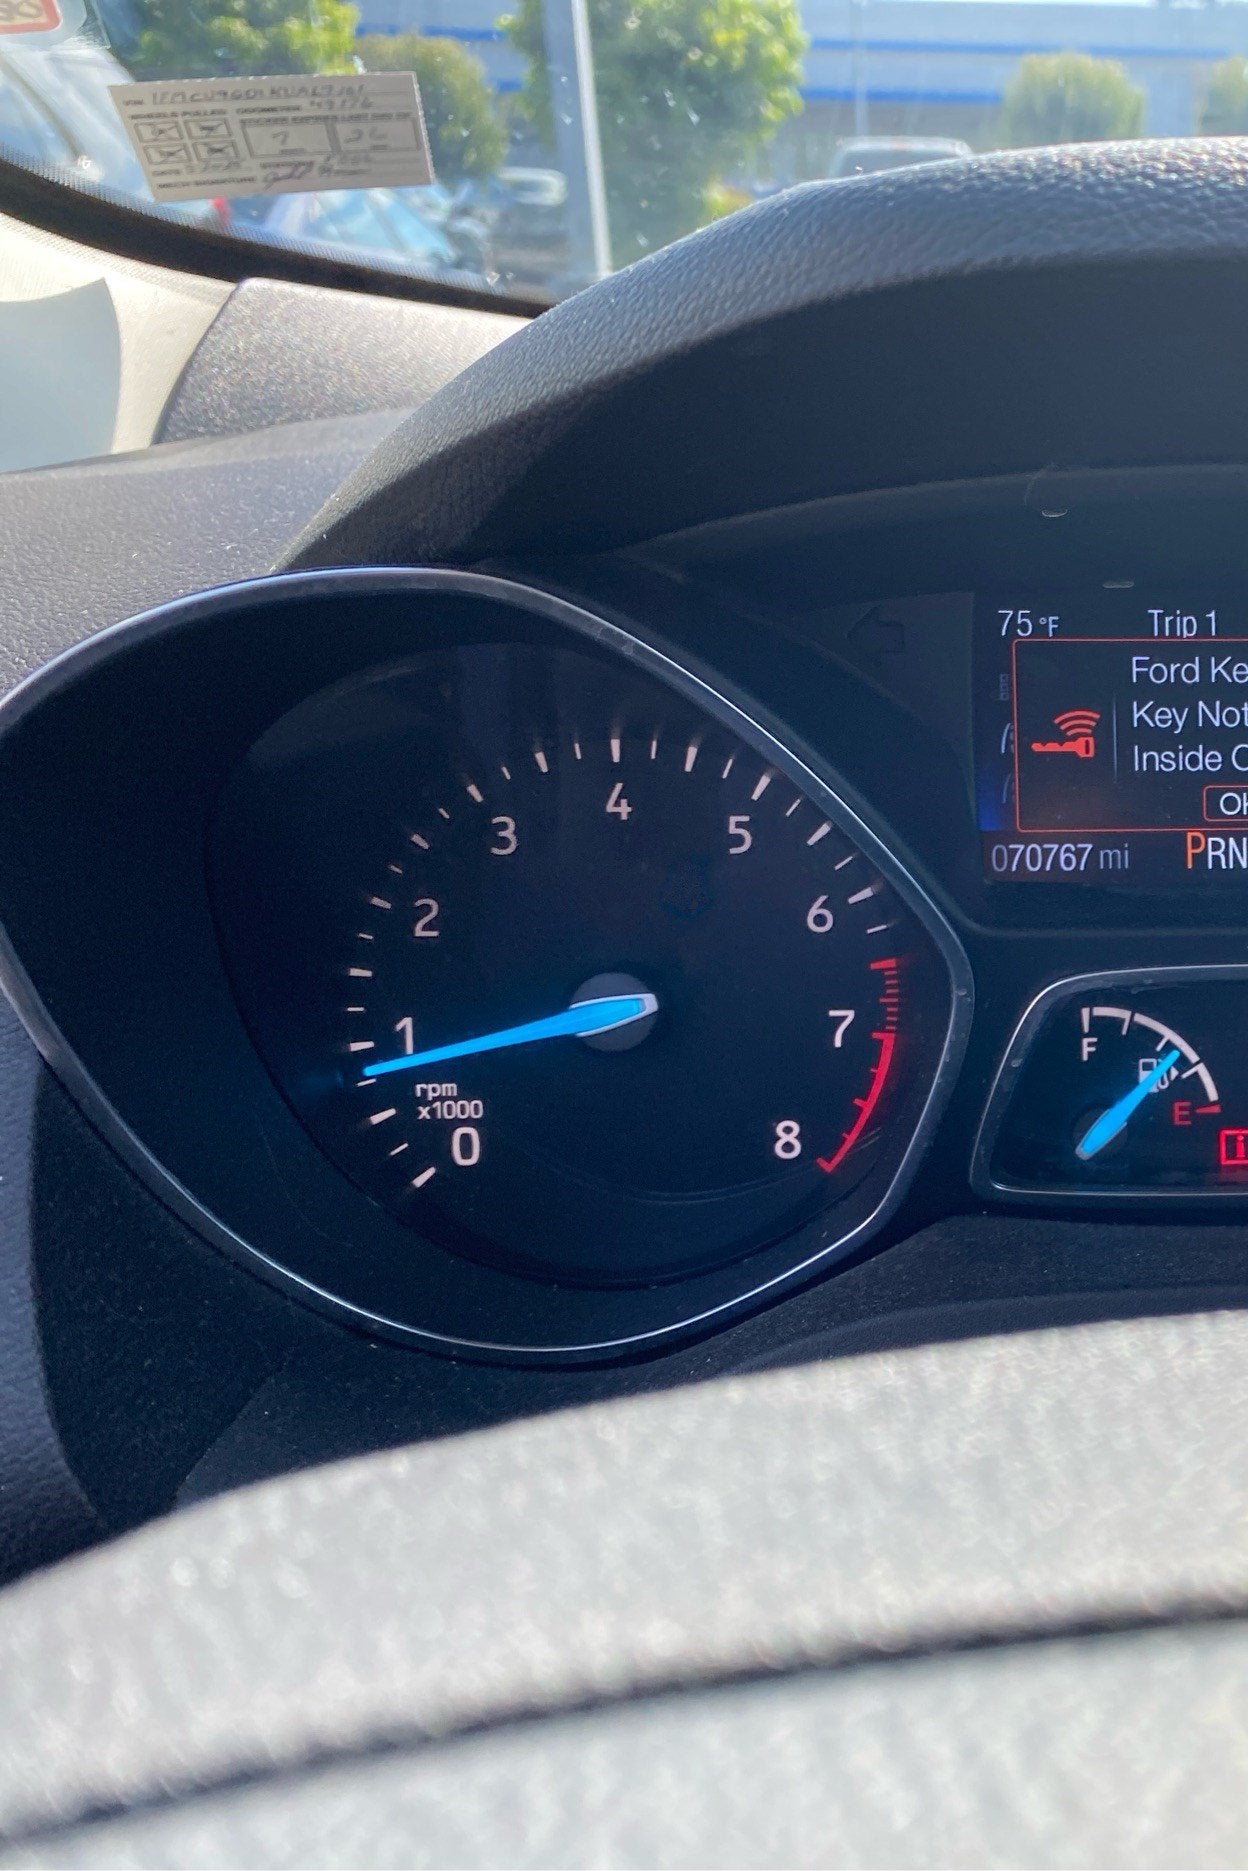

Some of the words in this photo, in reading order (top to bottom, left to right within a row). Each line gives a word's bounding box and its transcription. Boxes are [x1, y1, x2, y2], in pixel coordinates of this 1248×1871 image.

[997, 609, 1033, 637] 75
[1146, 608, 1199, 637] Trip
[1205, 609, 1216, 637] 1
[1131, 656, 1200, 684] Ford
[1132, 700, 1189, 734] Key
[1134, 744, 1223, 772] Inside
[605, 782, 632, 821] 4
[490, 815, 519, 856] 3
[728, 815, 753, 855] 5
[992, 843, 1094, 872] 070767
[1099, 842, 1129, 870] mi
[414, 898, 440, 937] 2
[806, 895, 834, 933] 6
[395, 1017, 415, 1054] 1
[828, 1009, 855, 1048] 7
[1081, 1037, 1098, 1062] F
[415, 1082, 458, 1100] rpm
[417, 1100, 484, 1120] x1000
[1172, 1101, 1191, 1126] E
[451, 1126, 481, 1167] 0
[774, 1119, 802, 1159] 8
